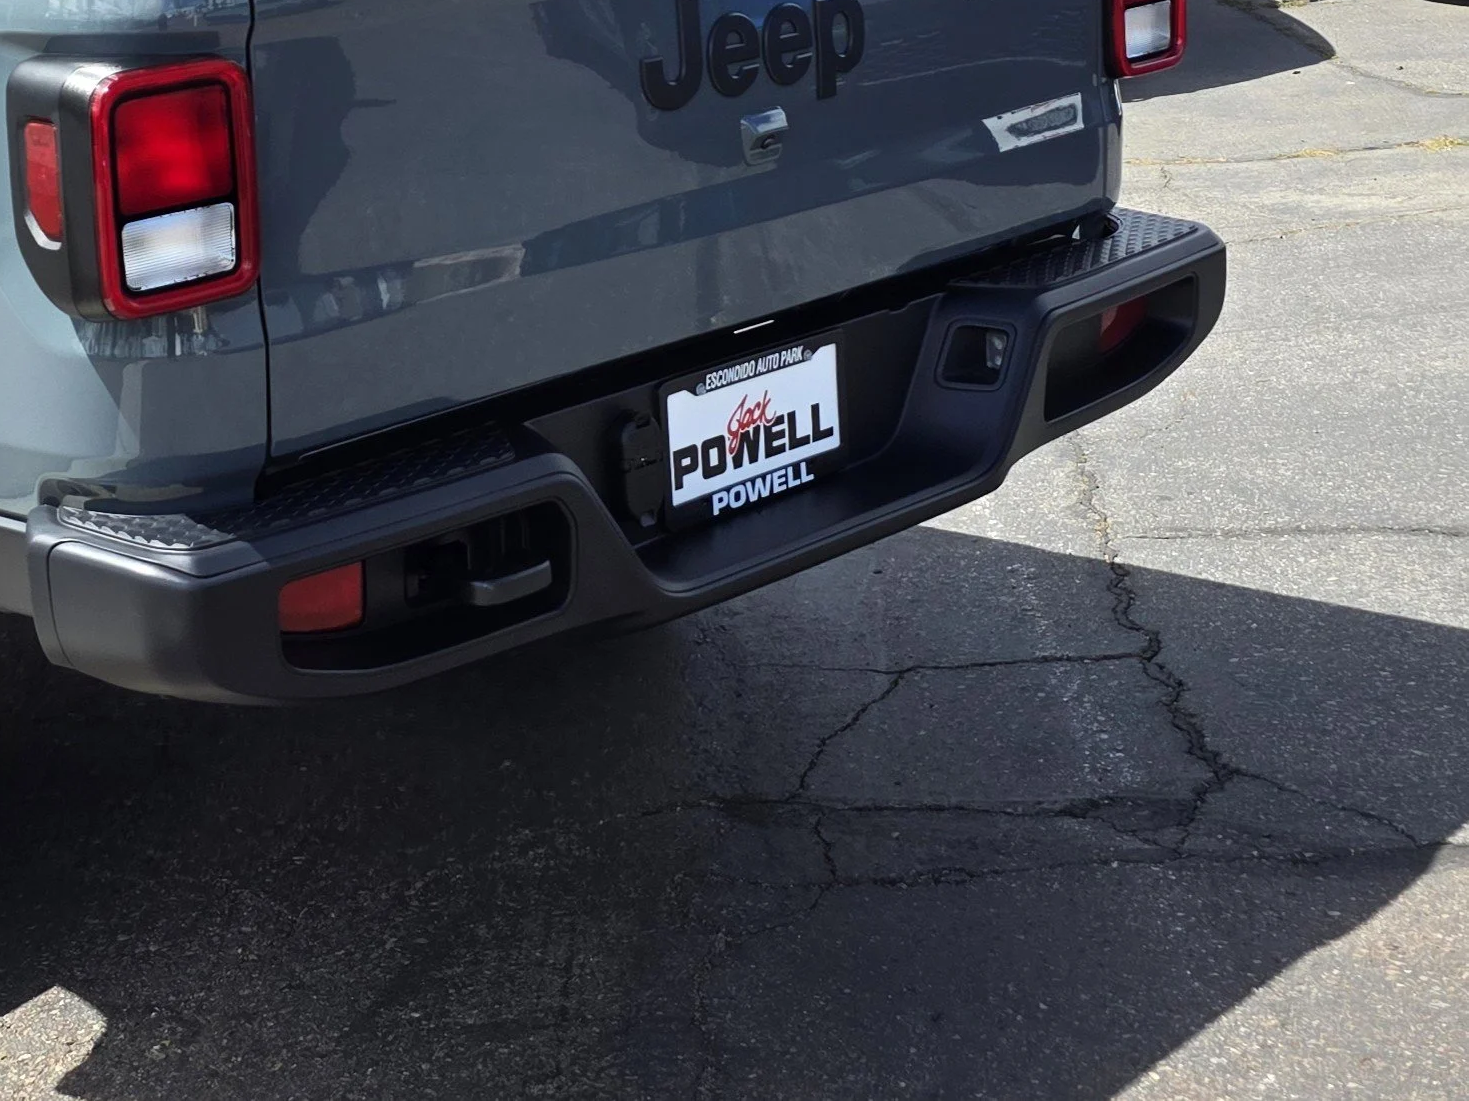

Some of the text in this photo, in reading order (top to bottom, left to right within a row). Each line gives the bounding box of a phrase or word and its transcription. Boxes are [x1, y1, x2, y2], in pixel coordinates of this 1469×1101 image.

[705, 345, 804, 391] ESCONDIDO AUTO PARK
[672, 402, 834, 491] POWELL
[727, 389, 776, 455] Jack
[712, 461, 815, 516] POWELL
